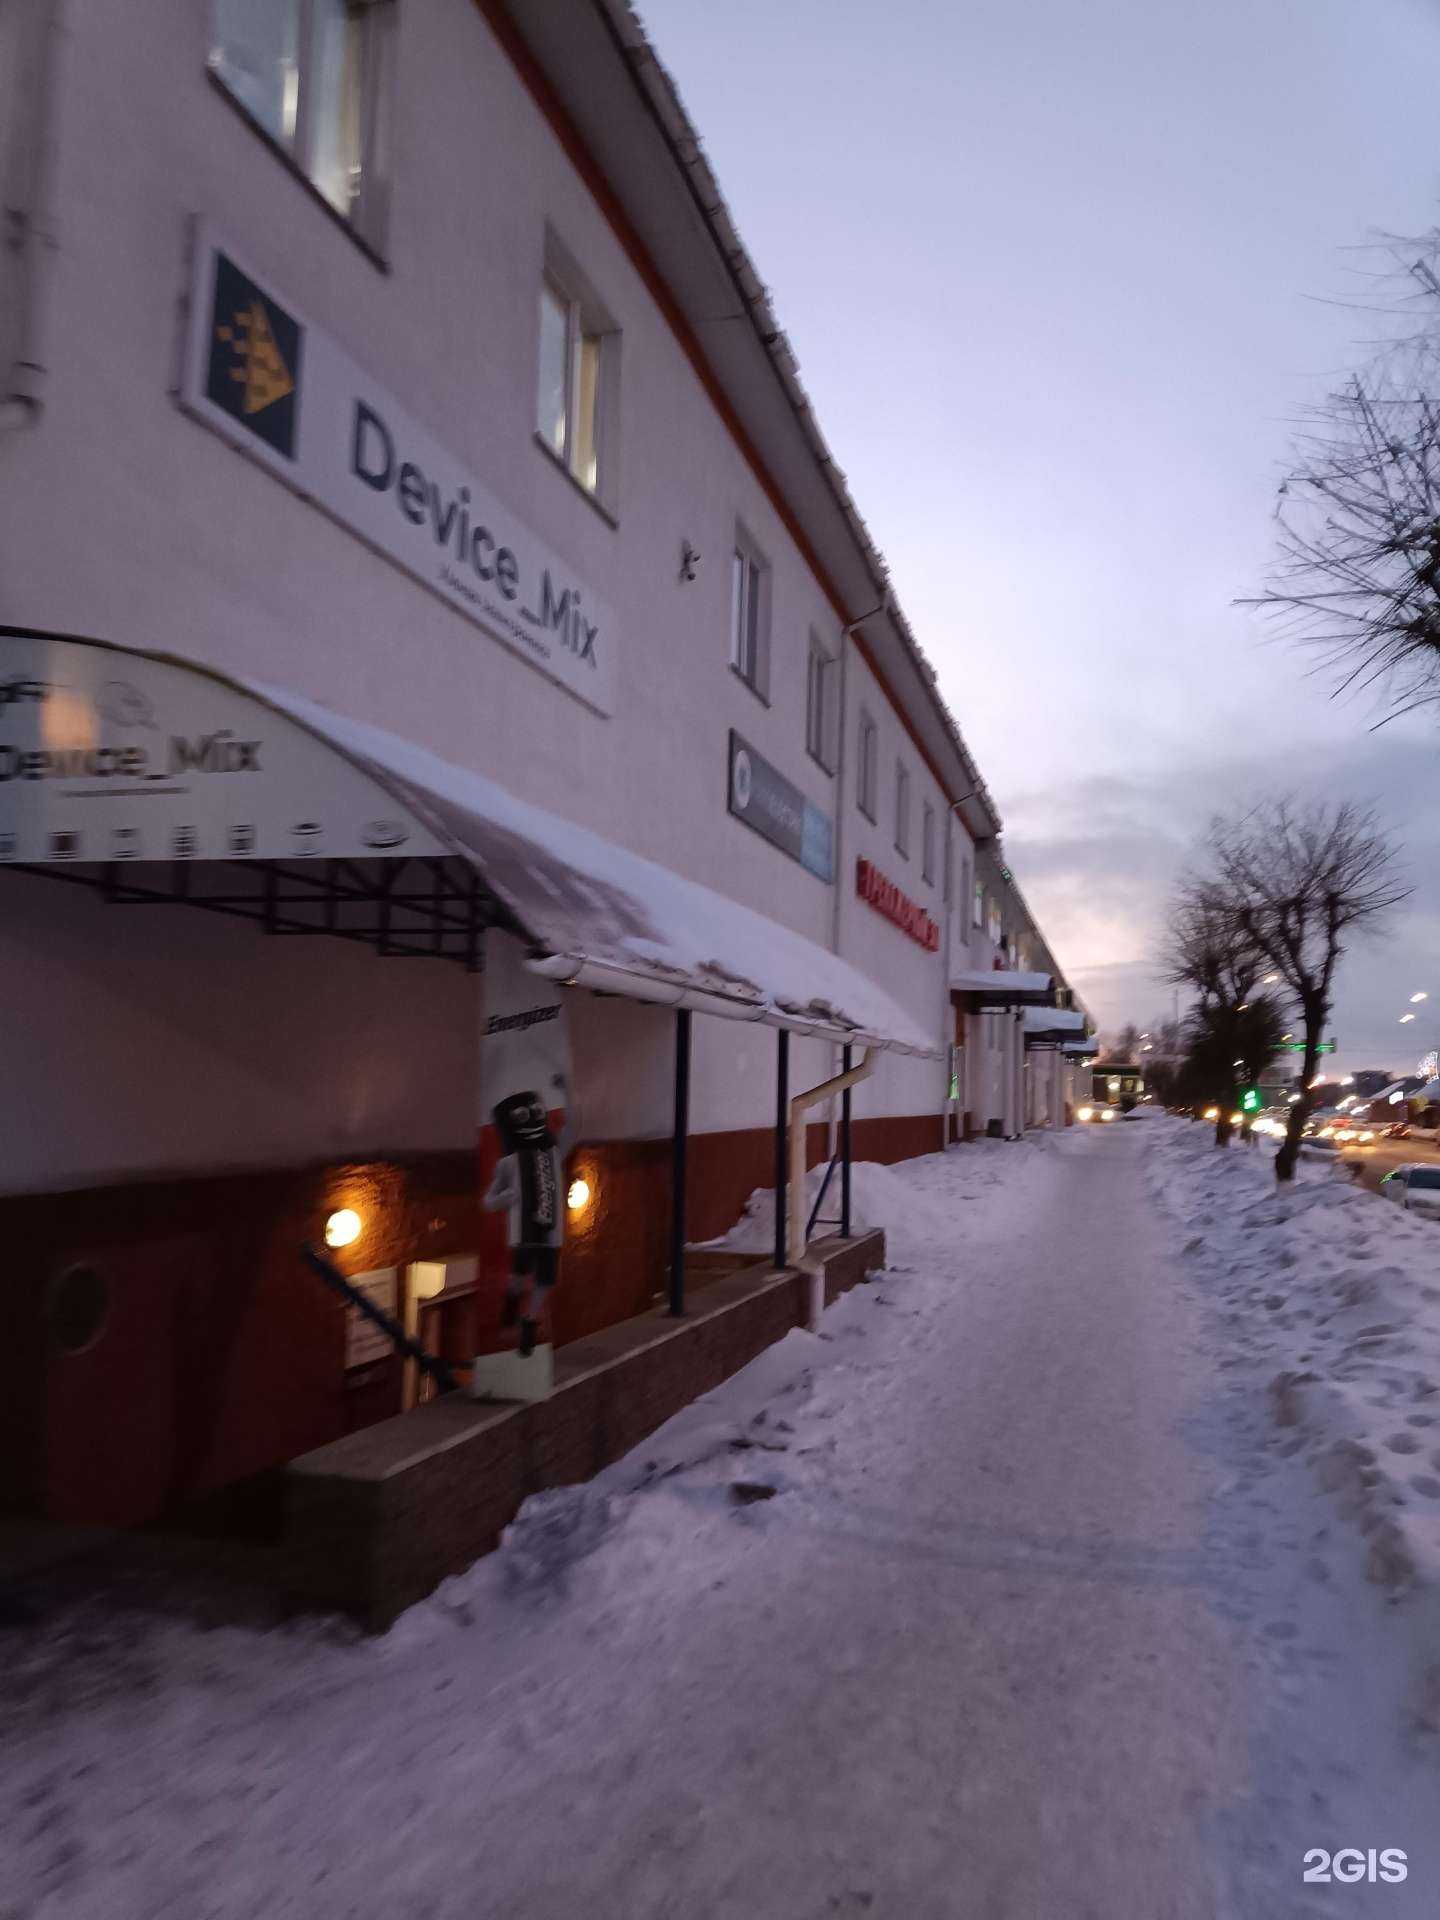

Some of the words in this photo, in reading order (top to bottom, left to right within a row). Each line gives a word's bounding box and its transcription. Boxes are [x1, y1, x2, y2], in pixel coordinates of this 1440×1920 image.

[351, 398, 600, 669] Device_Mix
[484, 1004, 563, 1035] Energizer
[536, 1150, 556, 1223] Energize
